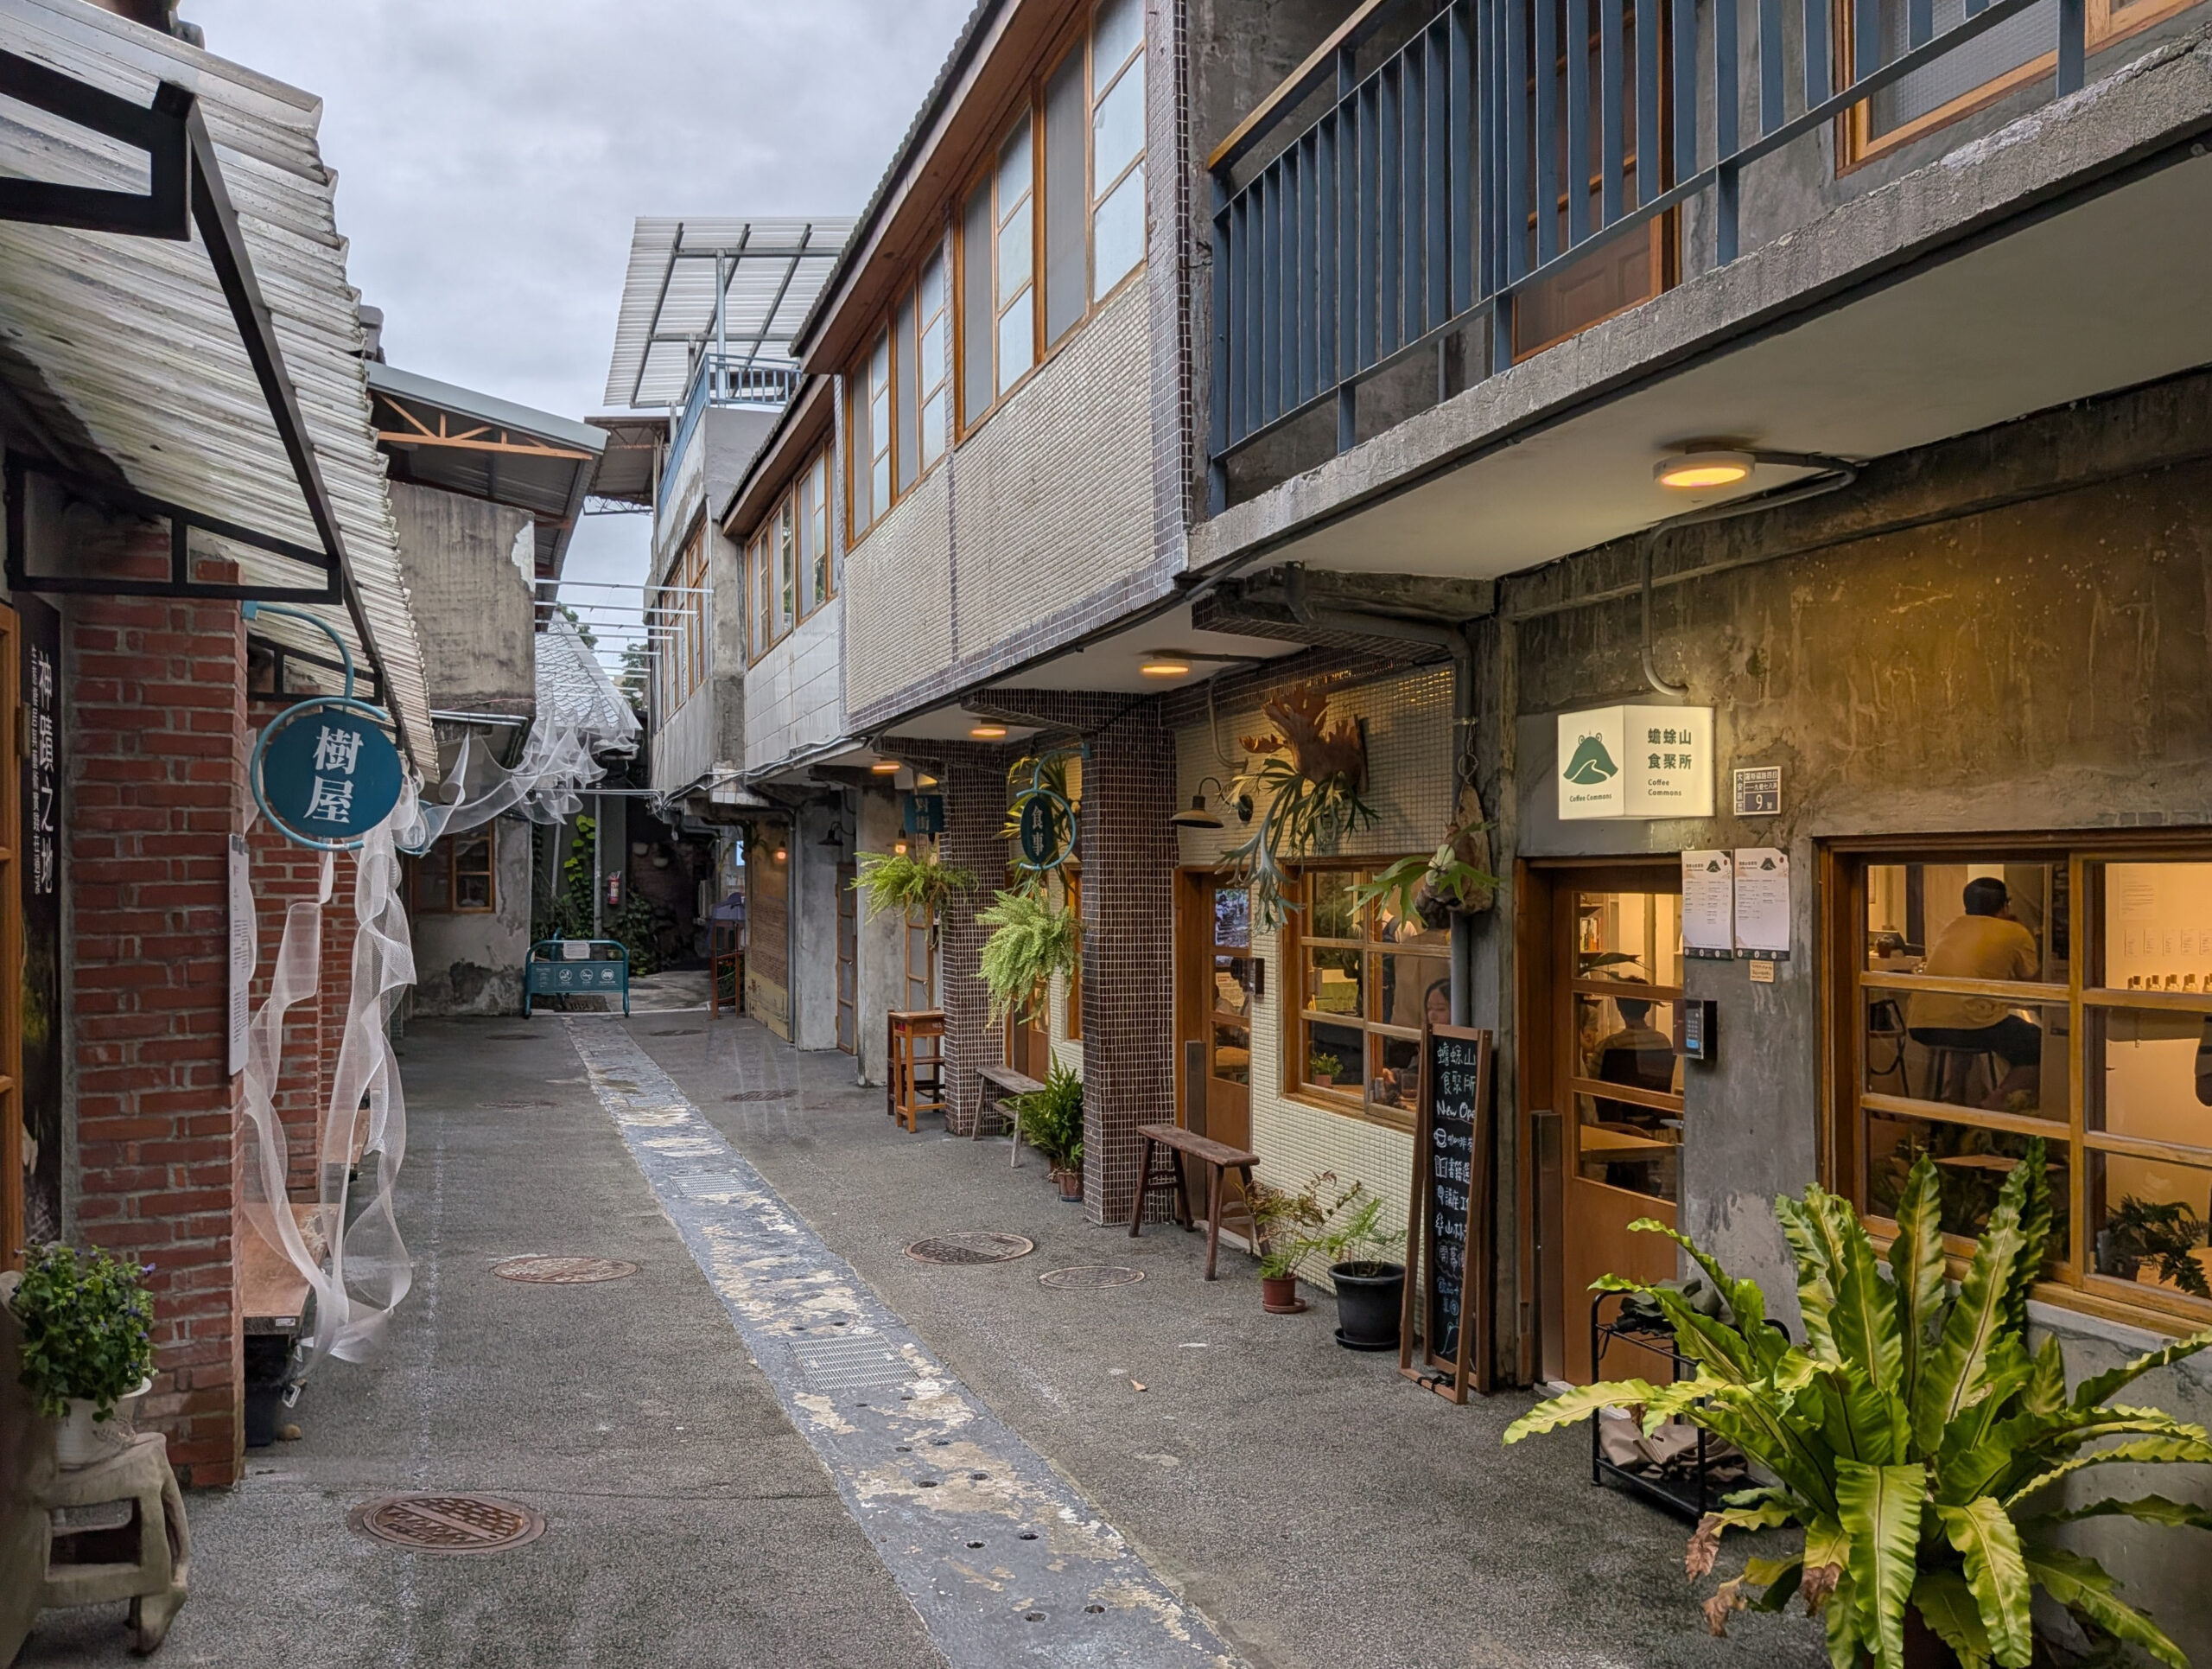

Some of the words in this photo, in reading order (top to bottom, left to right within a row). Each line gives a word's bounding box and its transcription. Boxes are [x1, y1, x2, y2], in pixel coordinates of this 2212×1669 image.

[1648, 728, 1692, 745] 蟾蜍山
[1648, 753, 1692, 769] 食聚所
[303, 725, 364, 823] 樹屋
[1569, 794, 1586, 803] Coffee
[1586, 793, 1612, 801] Commons
[1032, 805, 1044, 856] 食事
[1436, 1042, 1476, 1066] 蟾蜍山
[1440, 1070, 1476, 1097] 食聚所
[1436, 1099, 1457, 1117] New
[1459, 1101, 1475, 1120] Ope
